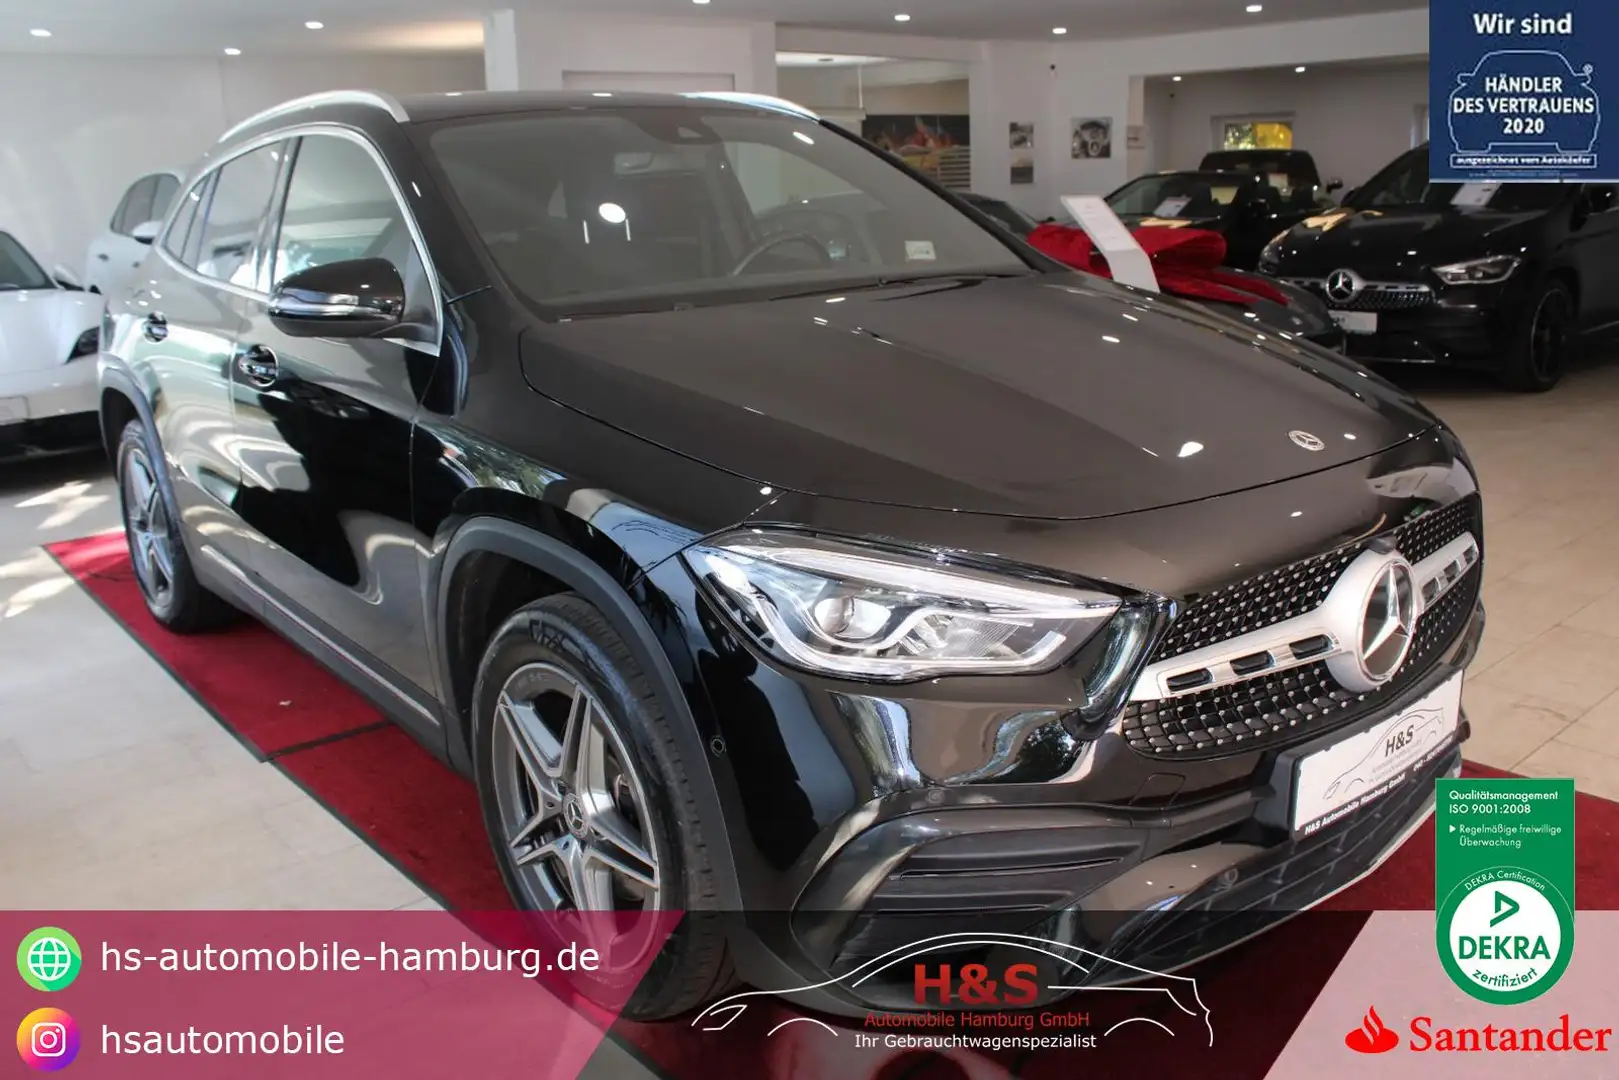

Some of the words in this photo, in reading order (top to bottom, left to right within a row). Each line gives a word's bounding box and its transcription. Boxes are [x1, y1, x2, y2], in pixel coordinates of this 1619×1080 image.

[1385, 724, 1414, 757] H&S
[1304, 820, 1320, 835] H&S
[1321, 801, 1359, 826] Automobile
[1360, 785, 1388, 805] Hamburg
